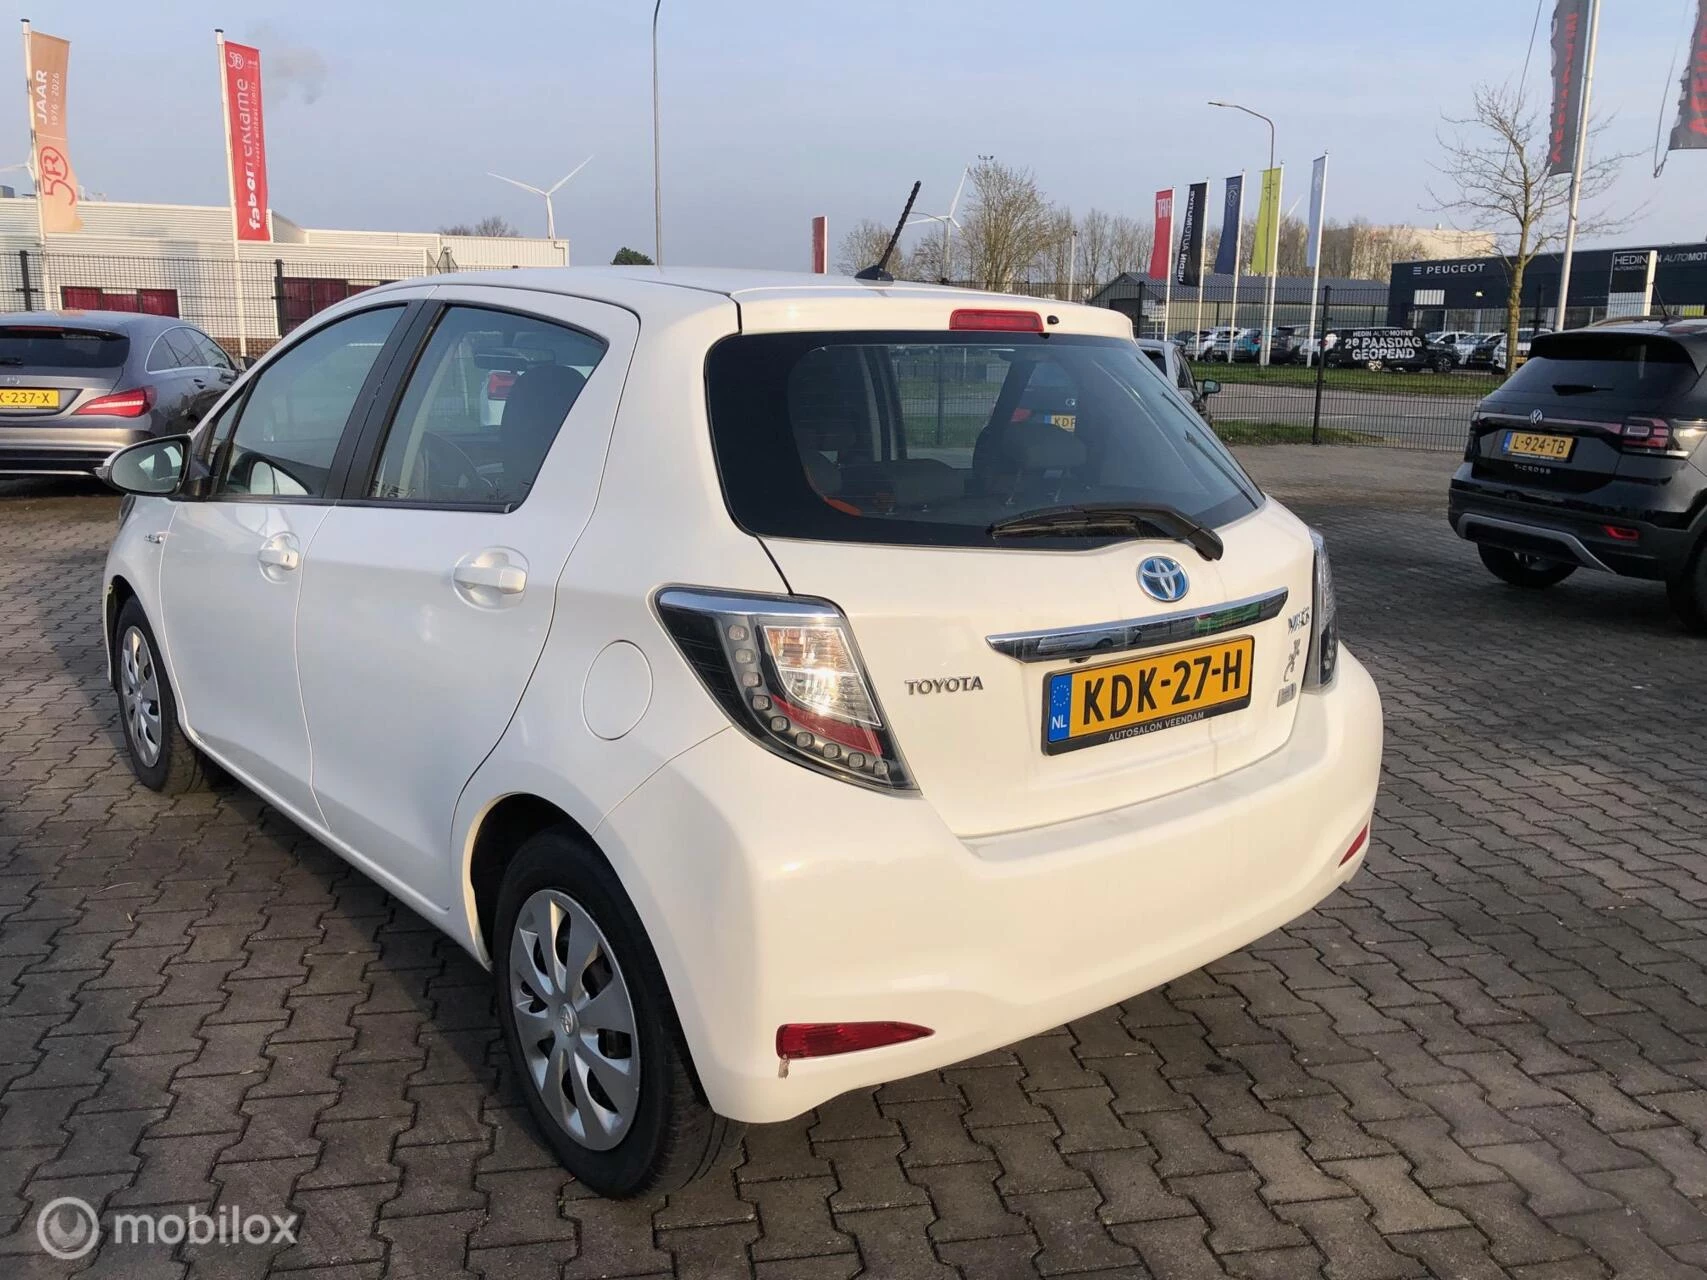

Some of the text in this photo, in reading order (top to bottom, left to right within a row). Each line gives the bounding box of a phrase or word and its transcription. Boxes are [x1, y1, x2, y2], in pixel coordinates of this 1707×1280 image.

[36, 70, 48, 124] JAAR
[1614, 254, 1648, 265] HEDIN
[1426, 263, 1485, 275] PEUGEOT
[1362, 336, 1422, 348] PAASDAG
[1352, 348, 1415, 360] GEOPEND
[1513, 435, 1566, 454] L-924-TB
[904, 676, 983, 695] TOYOTA
[1083, 649, 1242, 725] KDK-27-H
[1052, 715, 1067, 730] NL
[1108, 712, 1204, 742] AUTOSALON VEENDAM
